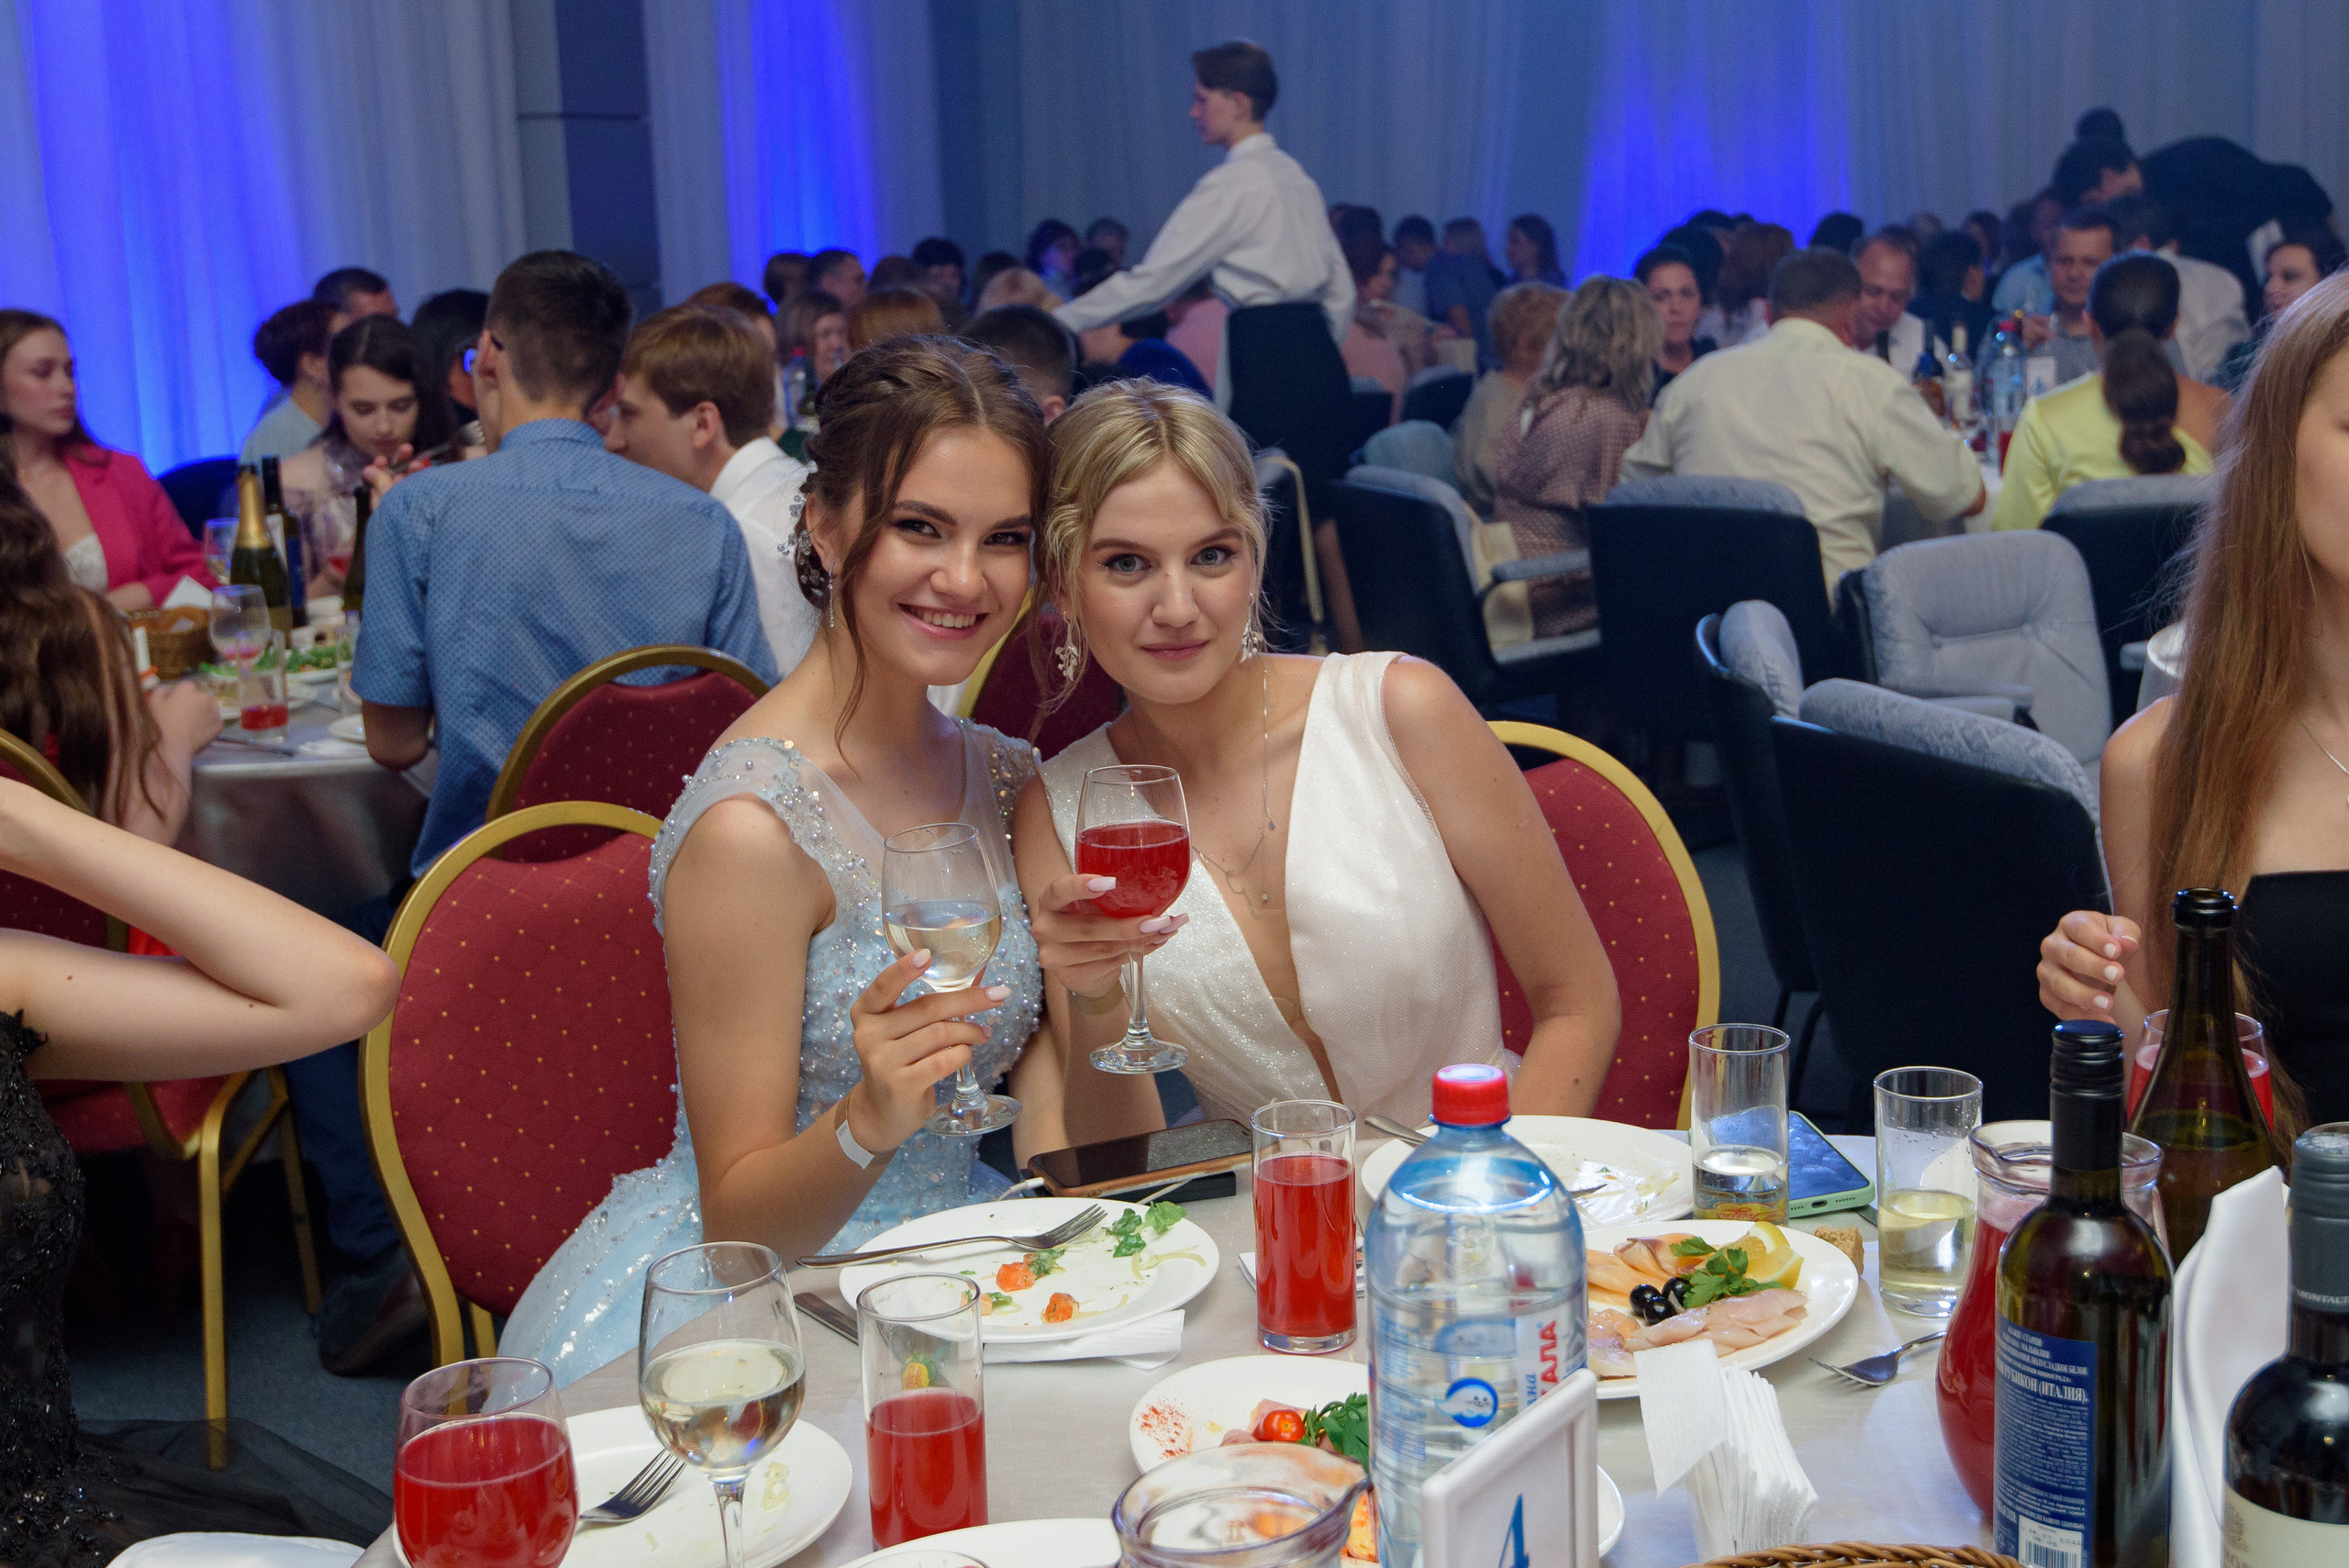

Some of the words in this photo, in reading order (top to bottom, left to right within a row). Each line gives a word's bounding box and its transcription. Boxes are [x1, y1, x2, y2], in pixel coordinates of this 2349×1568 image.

[1539, 1319, 1558, 1396] АЛА
[2004, 1363, 2037, 1392] РУБИКОН
[2038, 1380, 2088, 1404] (ИТАЛИЯ).
